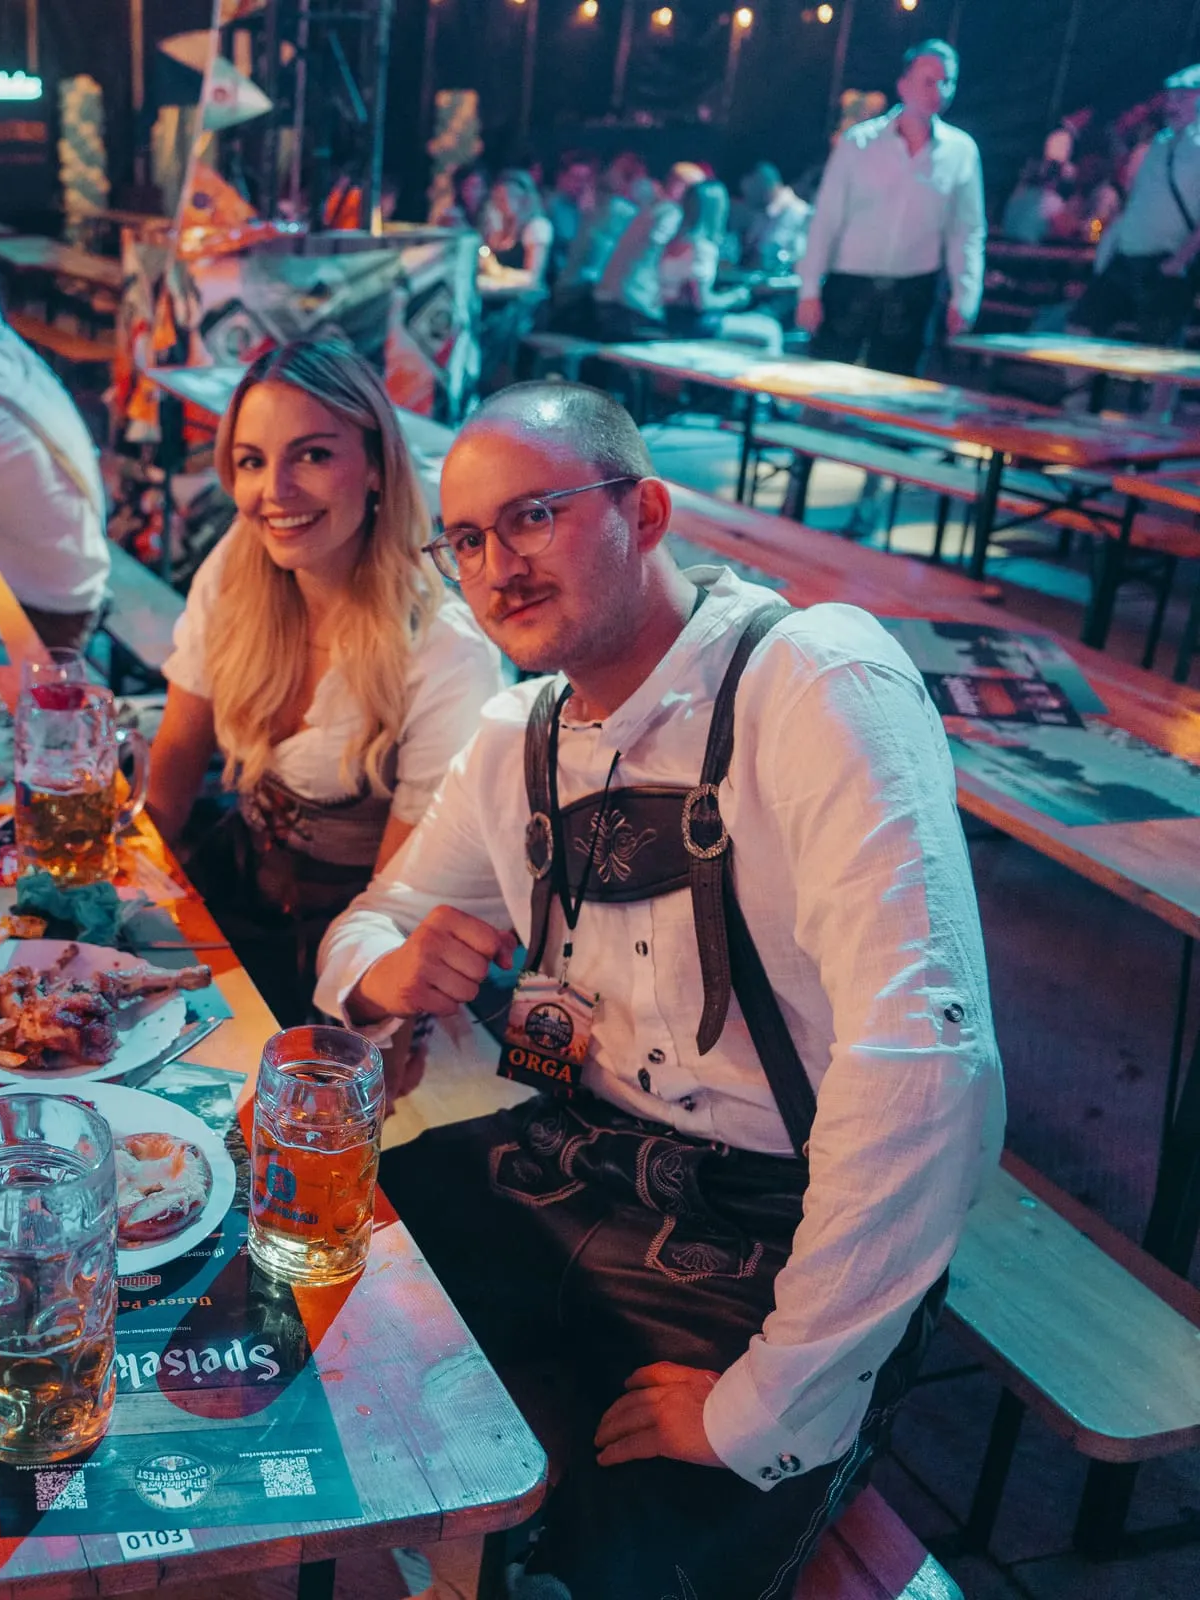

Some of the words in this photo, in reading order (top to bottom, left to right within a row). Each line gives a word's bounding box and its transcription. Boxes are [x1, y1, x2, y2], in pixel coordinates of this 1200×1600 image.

[508, 1048, 572, 1082] ORGA
[148, 1296, 213, 1306] Unsere
[136, 1465, 208, 1481] OKTOBERFEST
[126, 1529, 184, 1549] 0103
